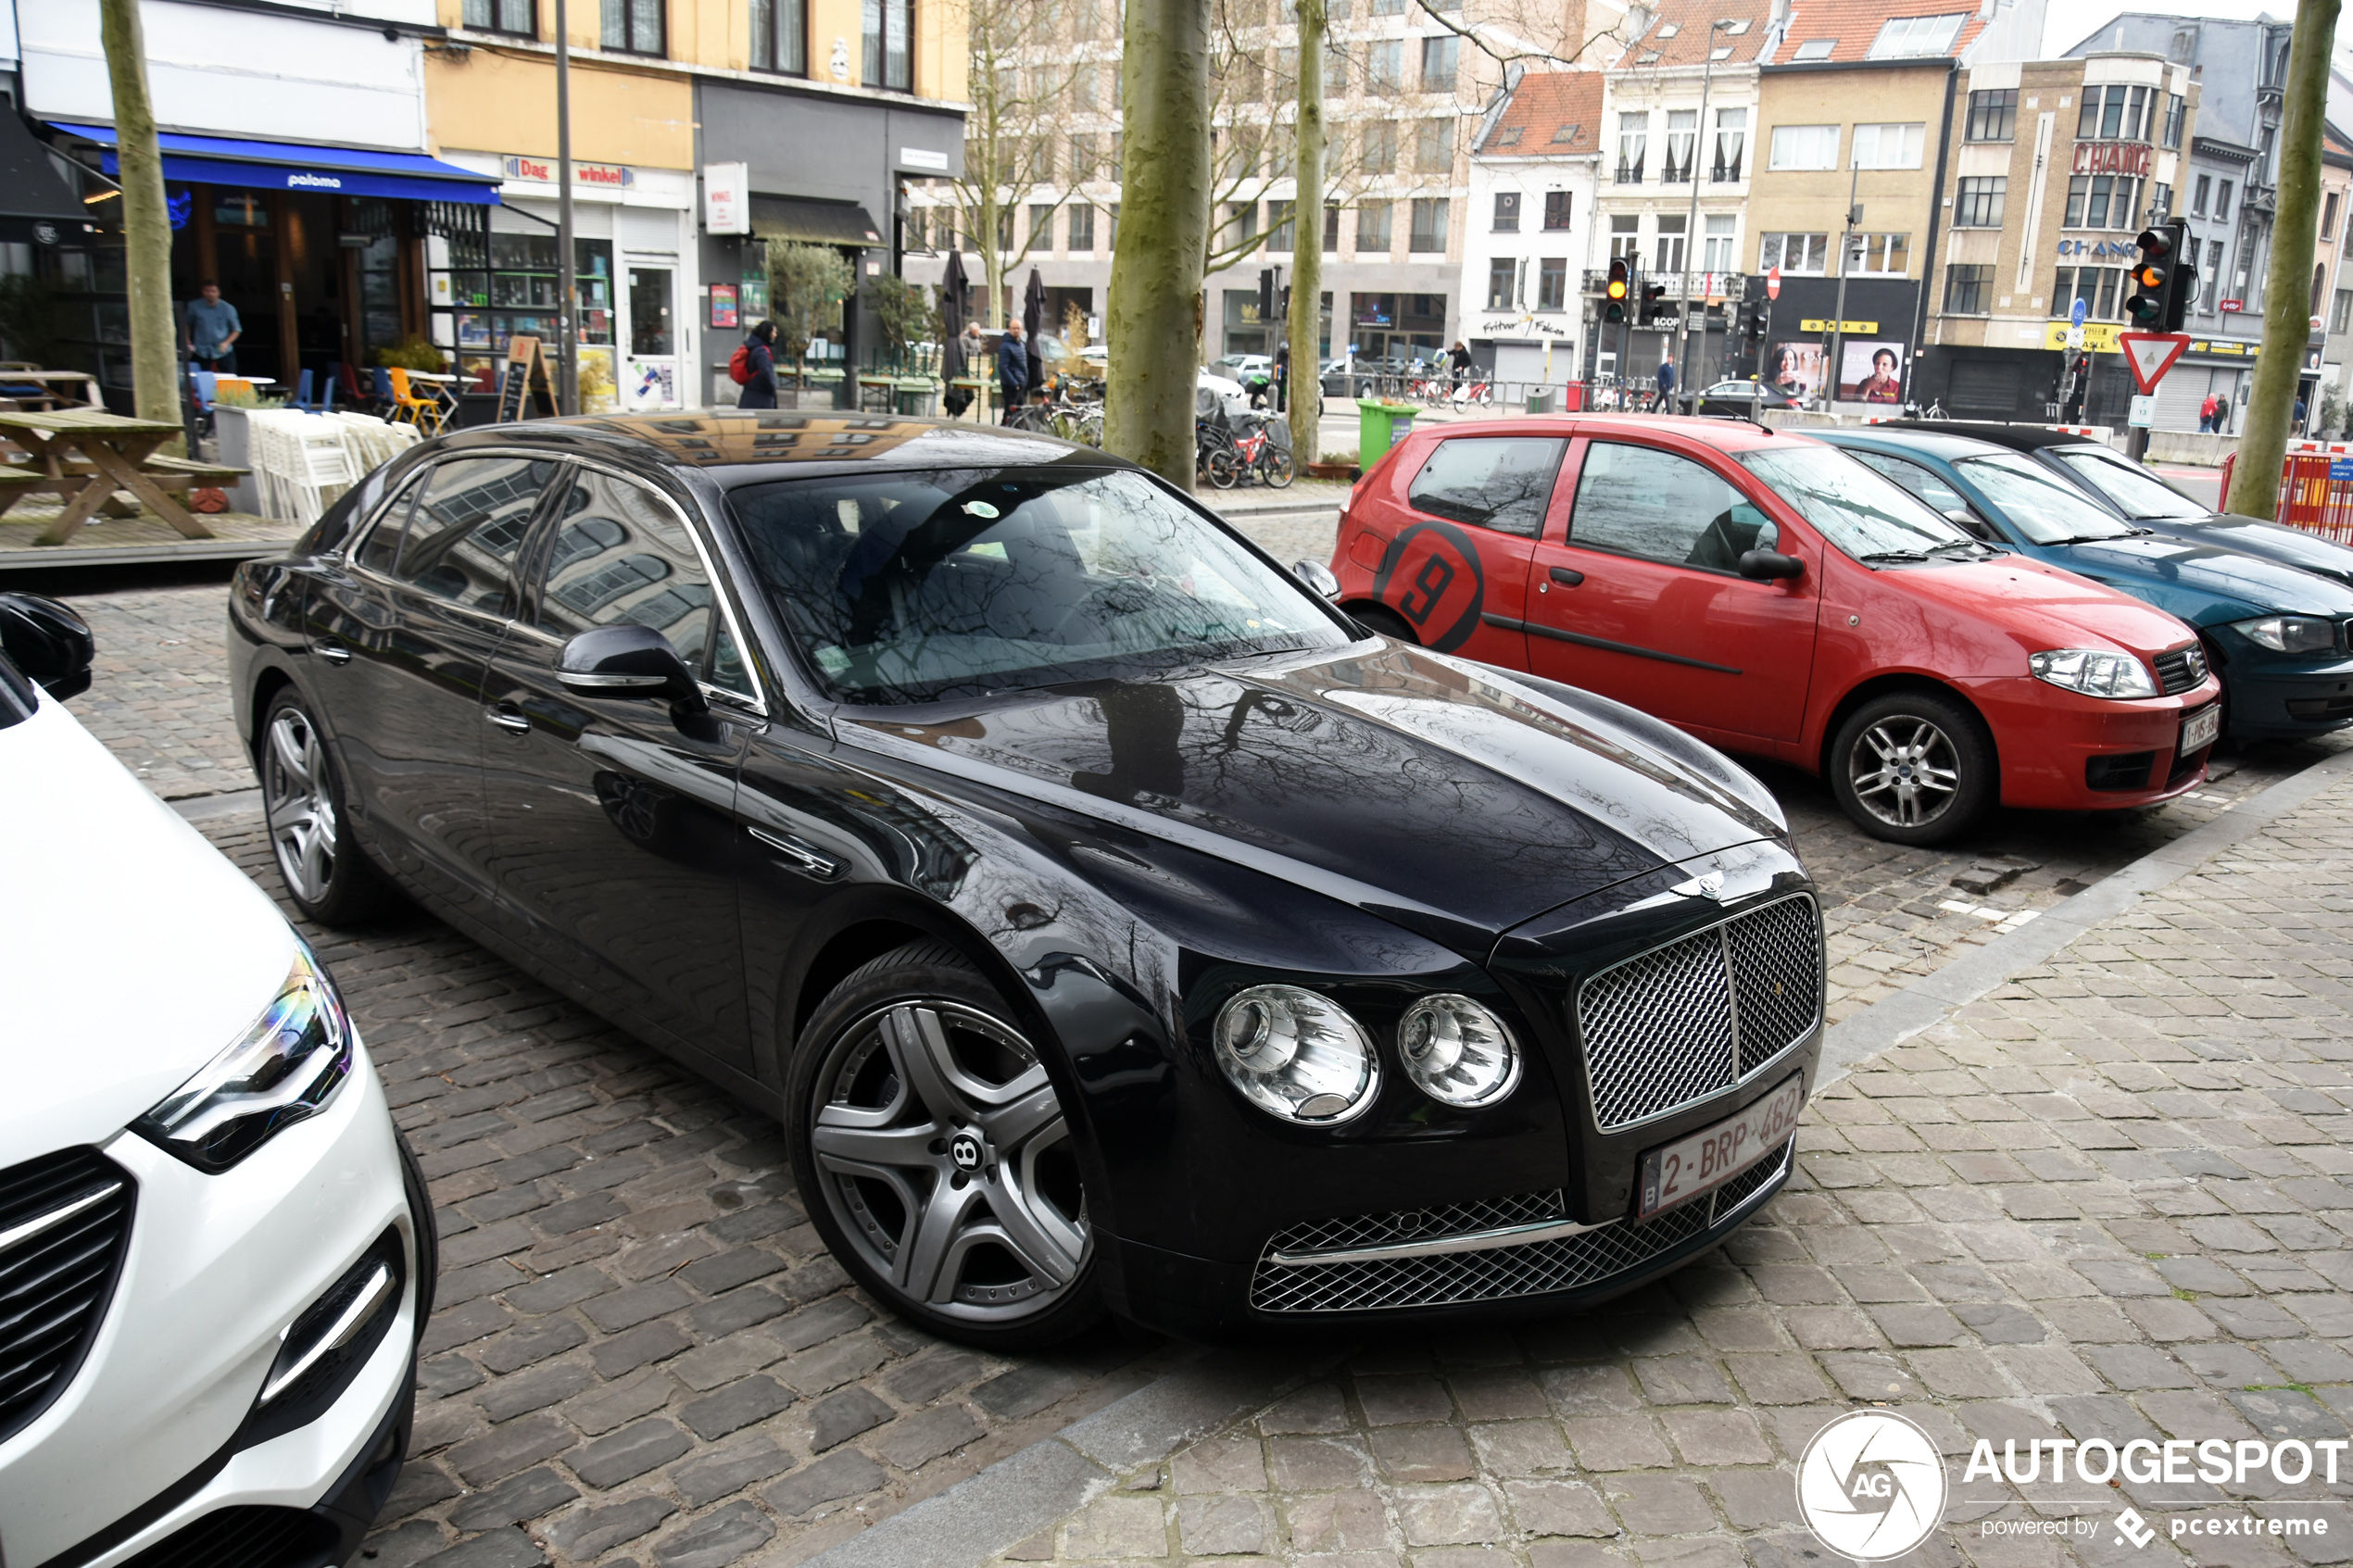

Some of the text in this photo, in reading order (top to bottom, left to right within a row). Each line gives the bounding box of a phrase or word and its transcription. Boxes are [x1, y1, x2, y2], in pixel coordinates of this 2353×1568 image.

[287, 173, 341, 188] paloma
[521, 159, 622, 183] Dag winkel
[1535, 320, 1565, 337] Falcon
[1662, 1087, 1797, 1198] 2-BRP-462
[1644, 1185, 1656, 1207] B
